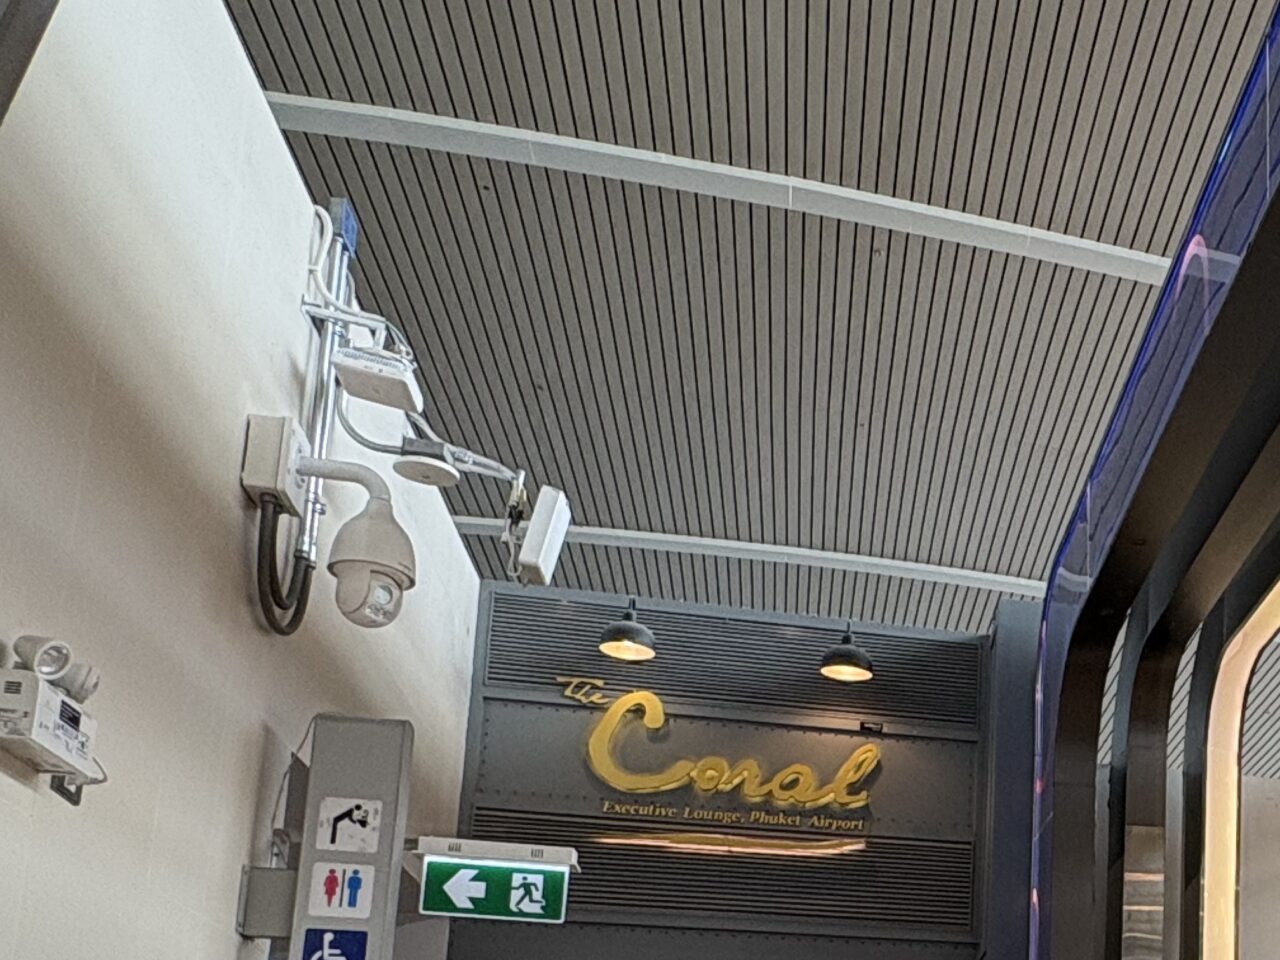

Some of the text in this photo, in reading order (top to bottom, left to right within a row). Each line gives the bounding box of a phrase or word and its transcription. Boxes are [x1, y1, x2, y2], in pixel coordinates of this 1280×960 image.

[556, 676, 609, 704] The
[588, 690, 881, 809] Coral
[602, 800, 678, 818] Executive
[750, 810, 801, 826] Phuket
[807, 814, 865, 831] Airport
